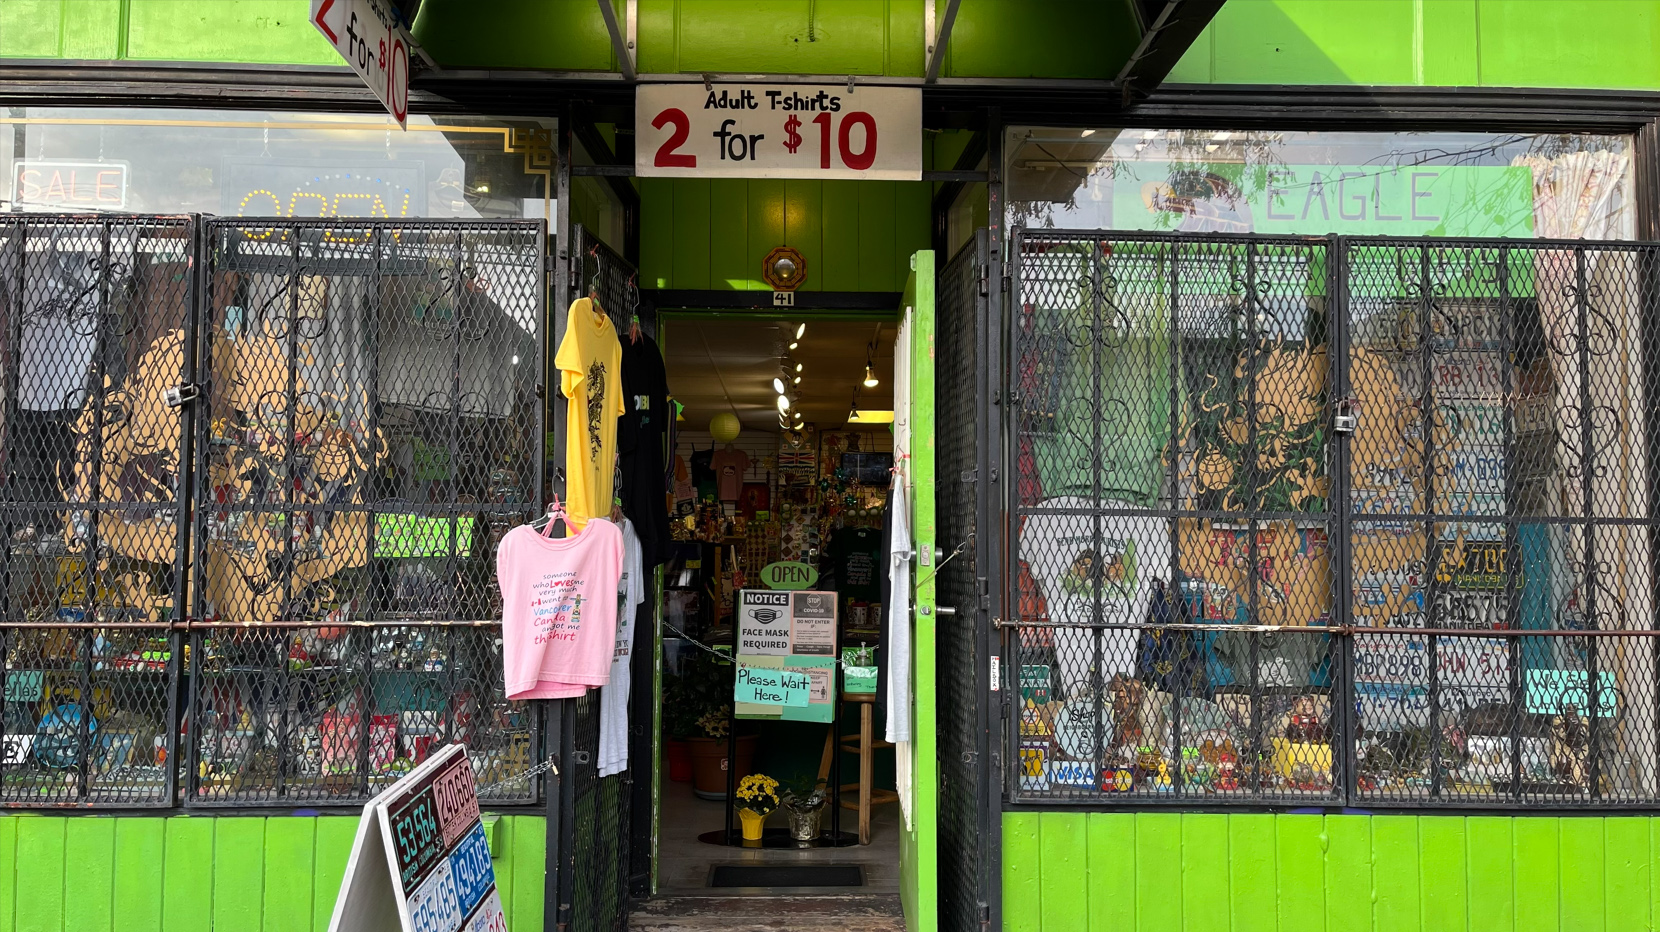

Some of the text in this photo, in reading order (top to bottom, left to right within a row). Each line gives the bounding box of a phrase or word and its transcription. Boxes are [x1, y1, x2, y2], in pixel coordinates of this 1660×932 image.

[346, 11, 374, 76] for
[704, 90, 841, 112] Adult T-shirts
[651, 107, 697, 168] 2
[713, 119, 765, 161] for
[20, 169, 122, 201] SALE
[1266, 171, 1442, 222] EAGLE
[239, 189, 411, 244] OPEN
[774, 291, 794, 306] 41
[543, 571, 577, 580] someone
[771, 565, 810, 583] OPEN
[532, 581, 550, 589] who
[542, 596, 561, 605] went
[746, 593, 787, 605] NOTICE
[742, 628, 763, 637] FACE
[765, 628, 789, 637] MASK
[743, 640, 788, 649] REQUIRED
[738, 668, 810, 690] Please Wait
[1056, 765, 1095, 780] VISA
